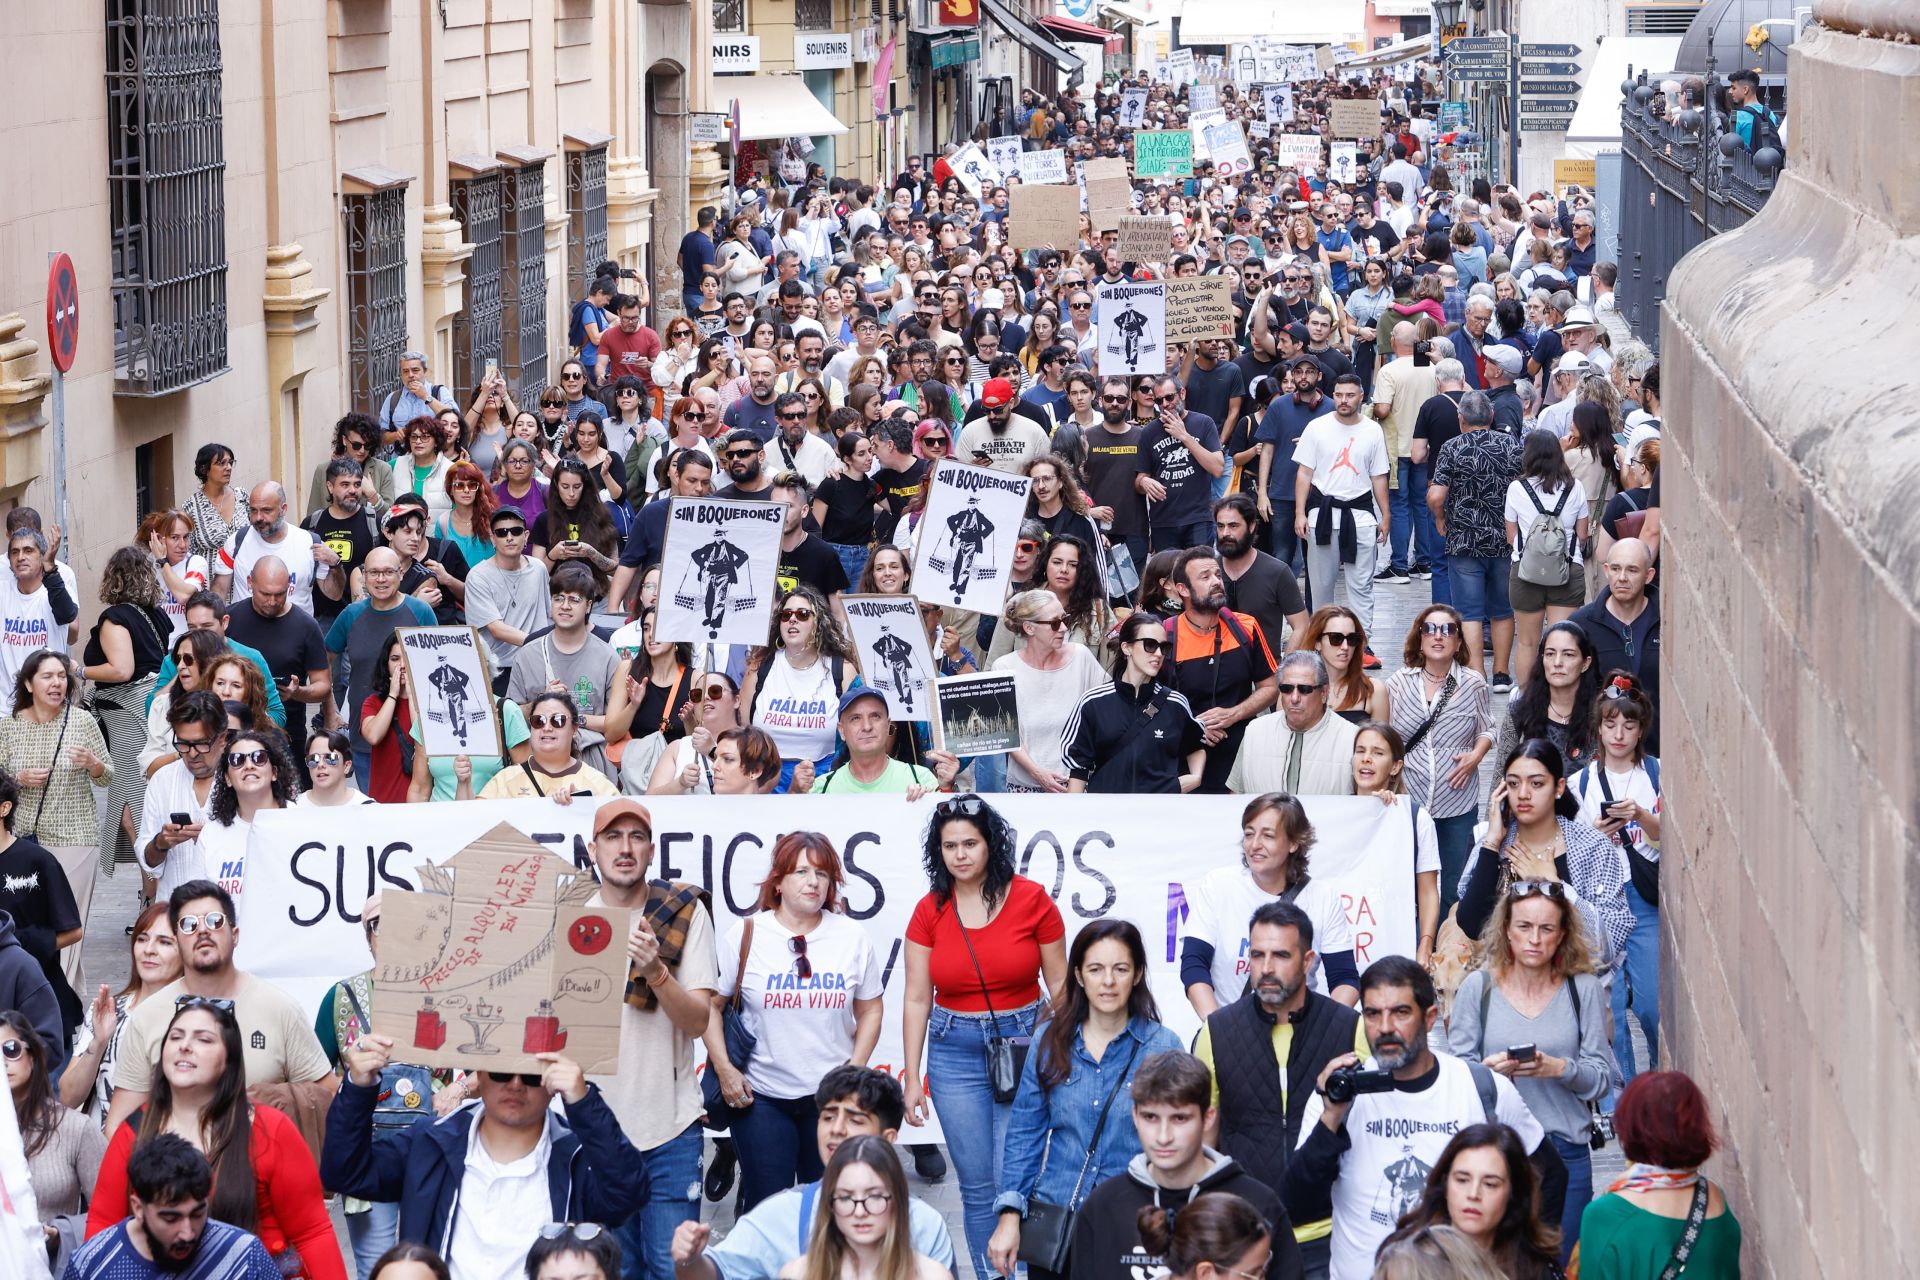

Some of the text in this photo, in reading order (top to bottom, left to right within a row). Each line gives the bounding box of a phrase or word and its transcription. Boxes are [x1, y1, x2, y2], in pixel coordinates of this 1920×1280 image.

[806, 42, 847, 55] SOUVENIRS
[1547, 83, 1566, 91] MÁLAGA
[1136, 134, 1147, 148] LA
[1120, 217, 1129, 230] NI
[1118, 232, 1125, 242] NI
[1156, 243, 1163, 251] EN
[1100, 285, 1163, 300] SIN BOQUERONES
[1165, 314, 1231, 326] UIENES VENDEN
[981, 440, 1026, 449] SABBATH
[983, 447, 1023, 455] CHURCH
[1160, 466, 1195, 480] GO HOME
[937, 469, 1028, 497] SIN BOQUERONES
[675, 506, 781, 525] SIN BOQUERONES
[848, 602, 916, 618] SIN BOQUERONES
[4, 616, 47, 633] MÁLAGA
[2, 633, 47, 646] PARA VIVIR
[404, 633, 473, 650] SIN BOQUERONES
[769, 697, 826, 714] MÁLAGA
[763, 712, 826, 729] PARA VIVIR
[289, 841, 416, 927] SUS
[511, 854, 547, 908] MÁLAGA
[500, 912, 519, 934] EN
[463, 949, 483, 967] DE
[419, 947, 465, 992] PRECIO
[766, 969, 847, 990] MÁLAGA
[764, 993, 847, 1009] PARA VIVIR
[1366, 1118, 1460, 1138] SIN BOQUERONES
